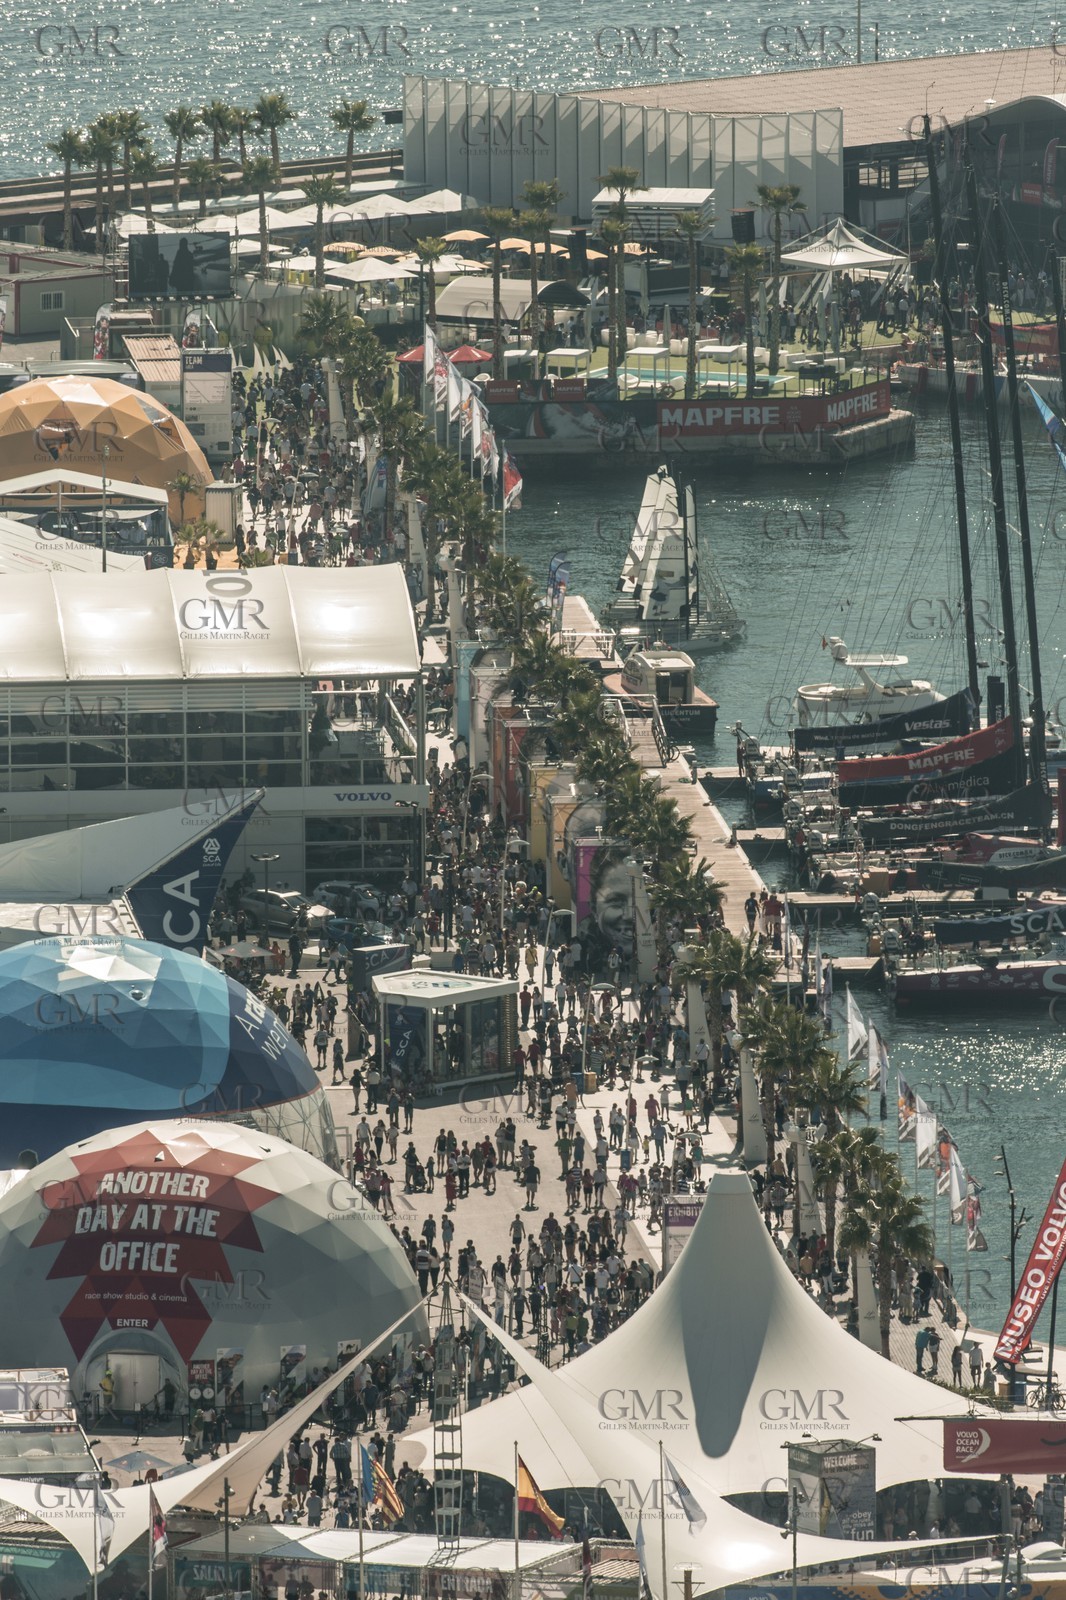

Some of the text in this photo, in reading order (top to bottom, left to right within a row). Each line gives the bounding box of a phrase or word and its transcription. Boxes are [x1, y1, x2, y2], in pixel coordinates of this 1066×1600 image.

[185, 356, 203, 365] TEAM
[661, 406, 780, 427] MAPFRE
[827, 391, 879, 422] MAPFRE
[904, 718, 950, 732] Vestas
[908, 748, 976, 770] MAPFRE
[334, 792, 392, 802] VOLVO
[890, 812, 1015, 831] DONGFENGRACETEAM.CN
[203, 855, 221, 863] SCA
[163, 870, 200, 957] CA
[1010, 911, 1065, 934] SCA
[365, 949, 390, 971] SCA
[235, 1014, 260, 1040] A
[395, 1030, 413, 1057] SCA
[96, 1170, 210, 1198] ANOTHER
[75, 1204, 220, 1237] DAY AT THE
[99, 1241, 181, 1273] OFFICE
[103, 1292, 123, 1300] show
[125, 1292, 149, 1300] studio
[151, 1293, 157, 1301] &
[159, 1294, 187, 1303] cinema
[116, 1318, 149, 1328] ENTER
[995, 1267, 1046, 1359] MUSEO
[823, 1454, 858, 1469] WELCOME
[852, 1511, 872, 1520] obey
[850, 1528, 874, 1541] fun
